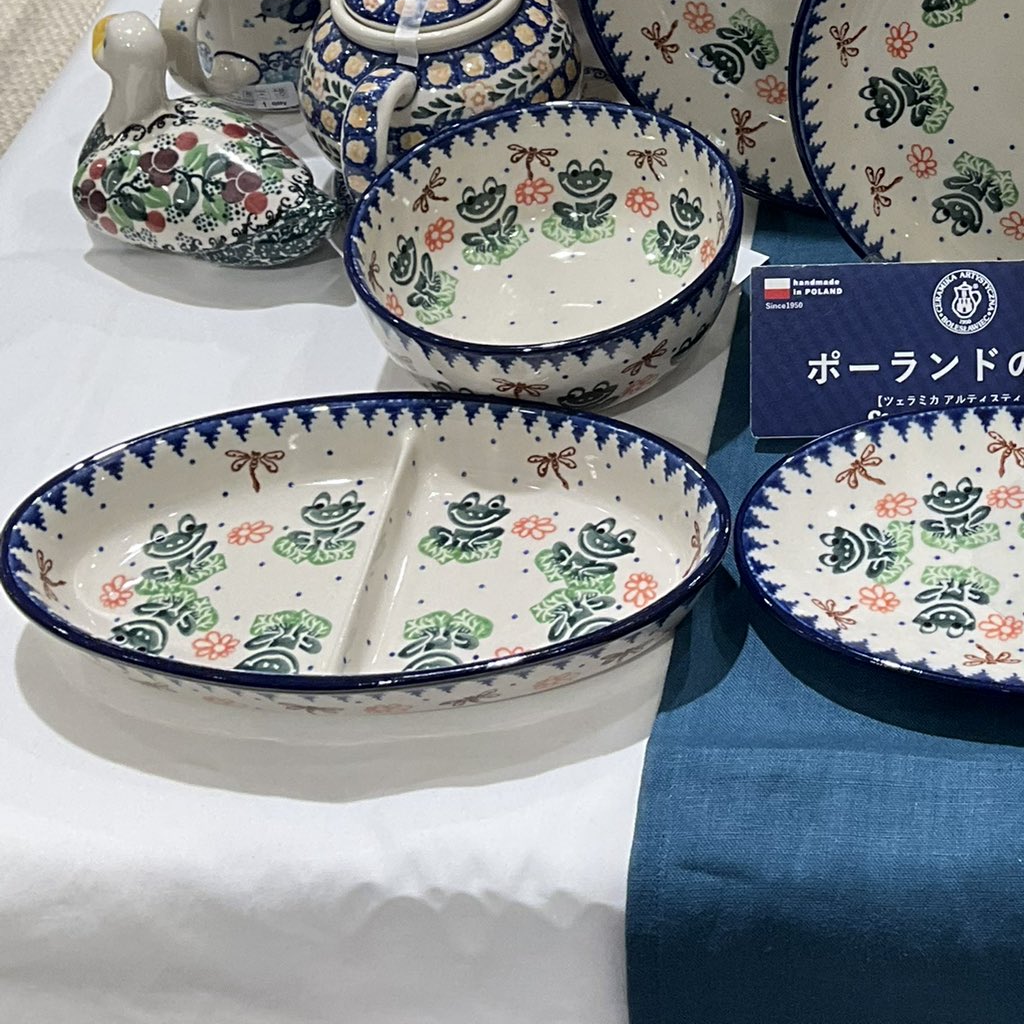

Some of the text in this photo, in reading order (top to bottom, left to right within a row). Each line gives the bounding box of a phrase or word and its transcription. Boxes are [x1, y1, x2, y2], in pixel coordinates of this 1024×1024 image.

[793, 278, 840, 286] handmade
[804, 288, 843, 296] POLAND
[935, 271, 995, 313] CERAMIKA ARTYSTYCZNA
